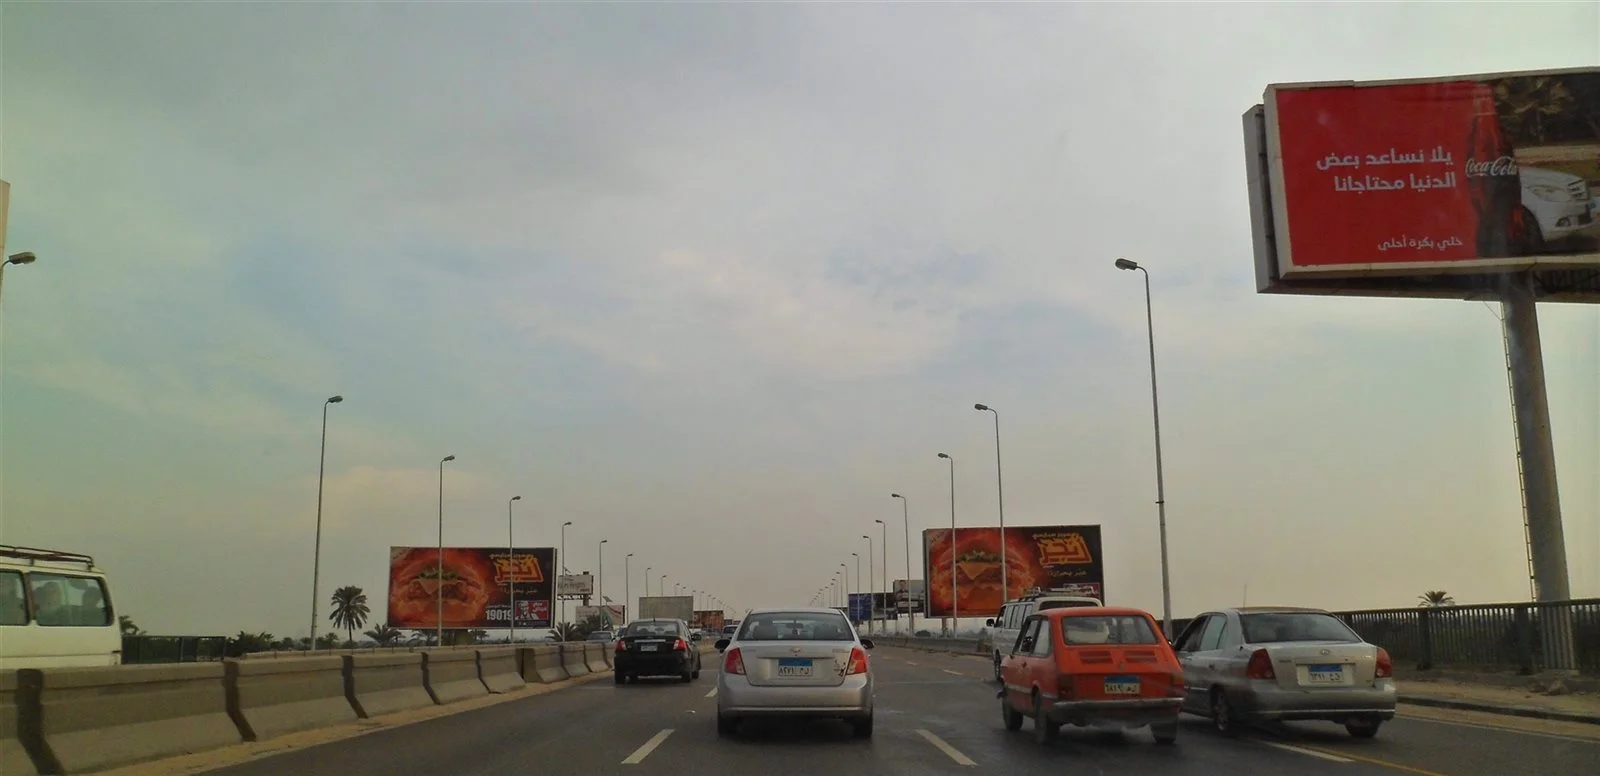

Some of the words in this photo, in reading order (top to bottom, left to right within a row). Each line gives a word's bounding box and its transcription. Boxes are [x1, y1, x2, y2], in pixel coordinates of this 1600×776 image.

[1316, 152, 1360, 170] بعض
[1365, 147, 1424, 166] نساعد
[1429, 146, 1454, 166] يلا
[1465, 156, 1517, 177] Coca-Cola
[1334, 175, 1405, 194] محتاجانا
[1409, 172, 1456, 192] الدنيا
[1409, 236, 1434, 250] بكرة
